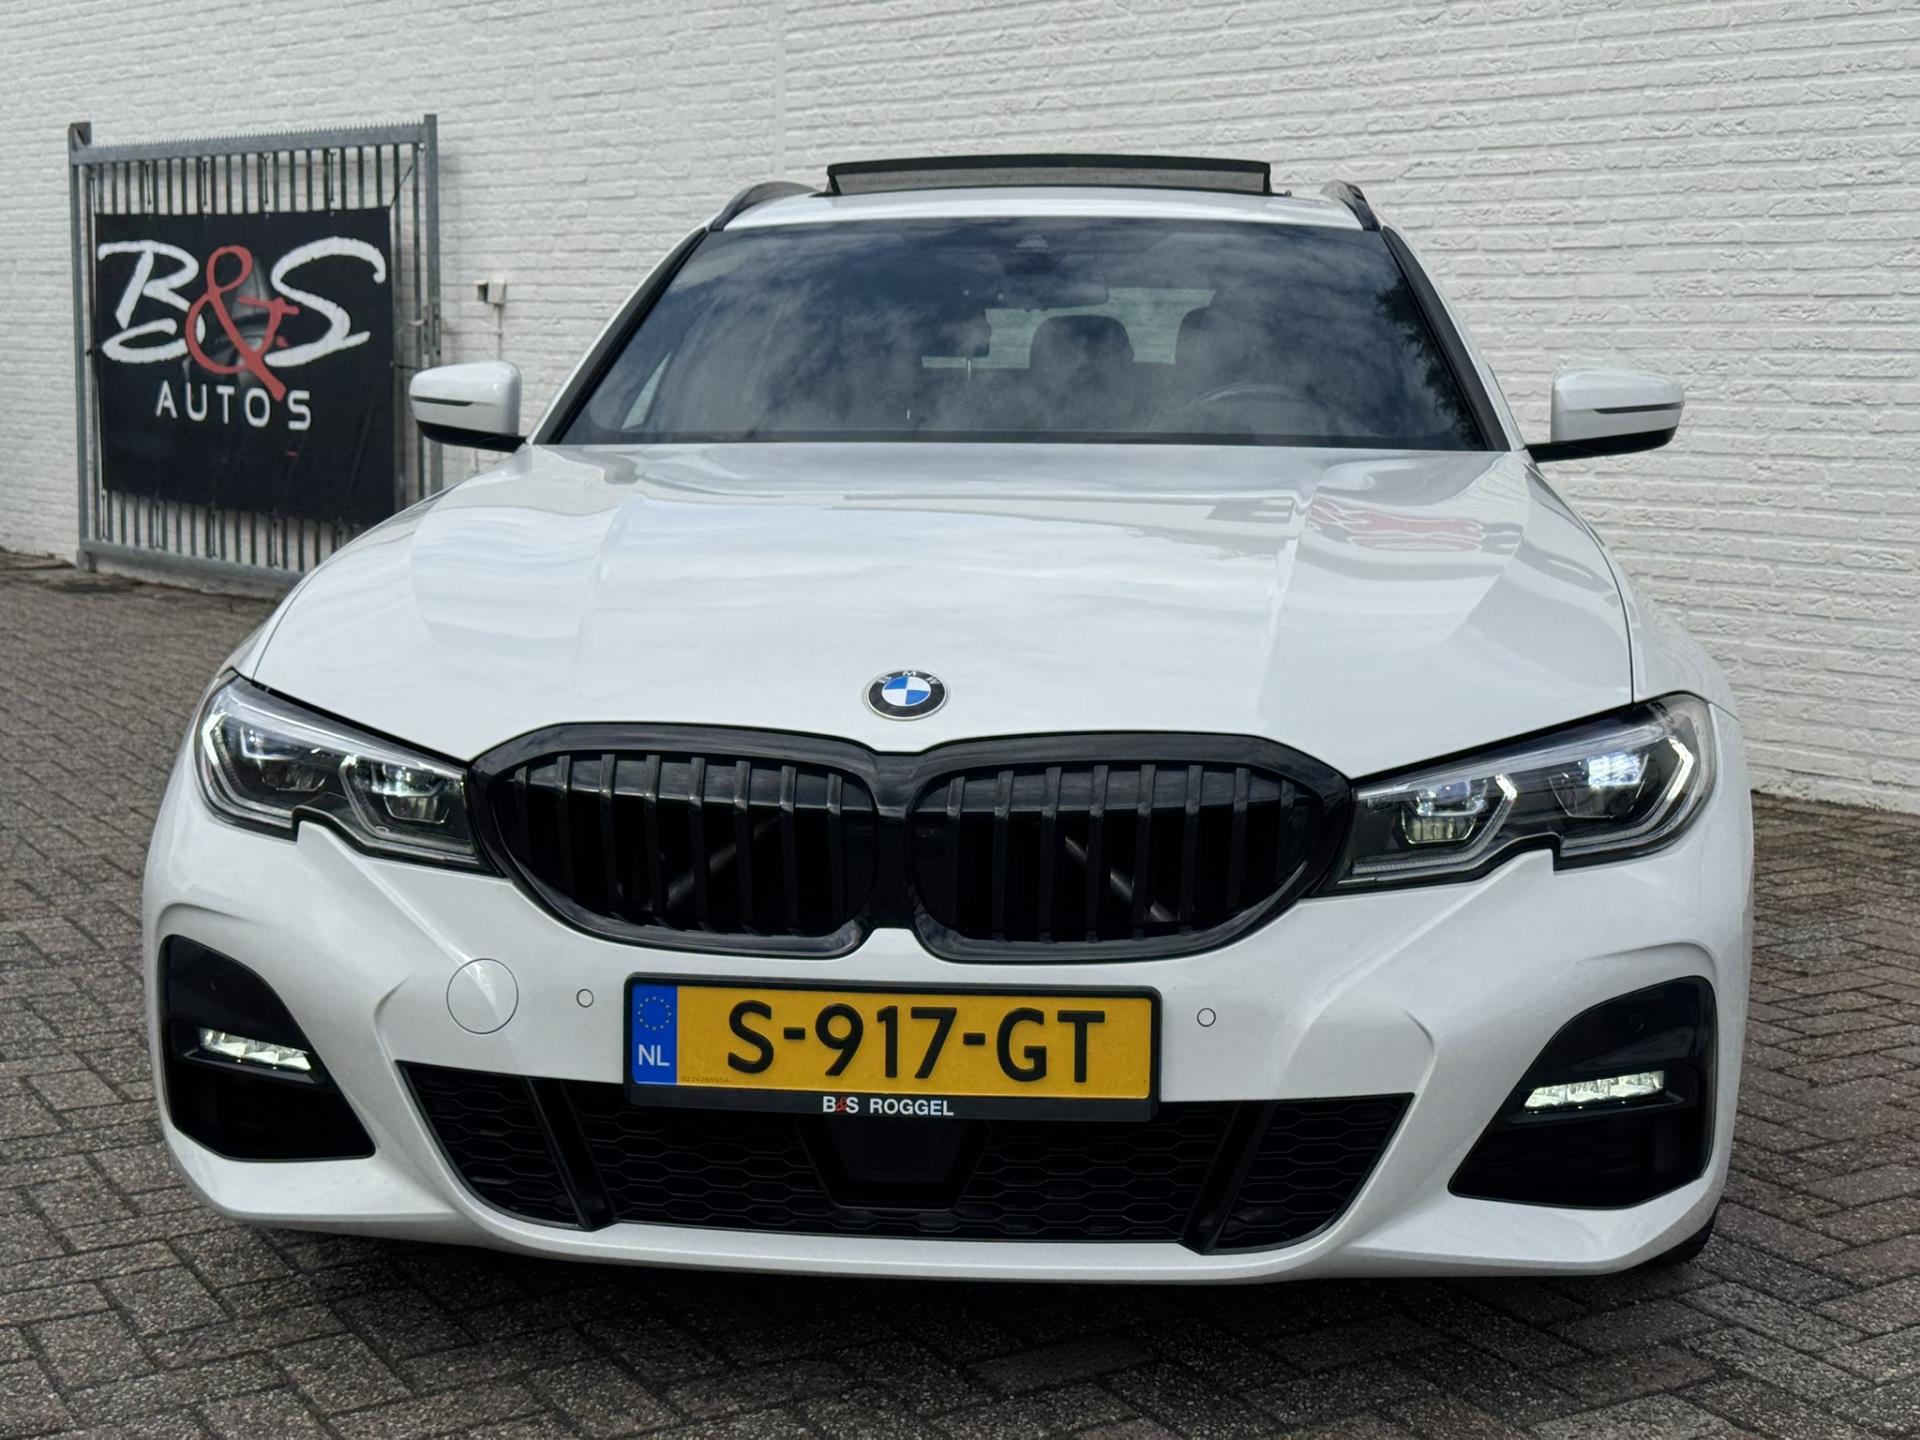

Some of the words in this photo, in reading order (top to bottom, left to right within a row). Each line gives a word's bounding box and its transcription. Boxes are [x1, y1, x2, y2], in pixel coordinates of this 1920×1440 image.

[97, 236, 387, 401] B&S
[155, 379, 312, 431] AUTOS
[638, 1044, 670, 1067] NL
[727, 999, 1106, 1083] S-917-GT
[822, 1095, 860, 1114] B&S
[869, 1097, 955, 1116] ROGGEL
